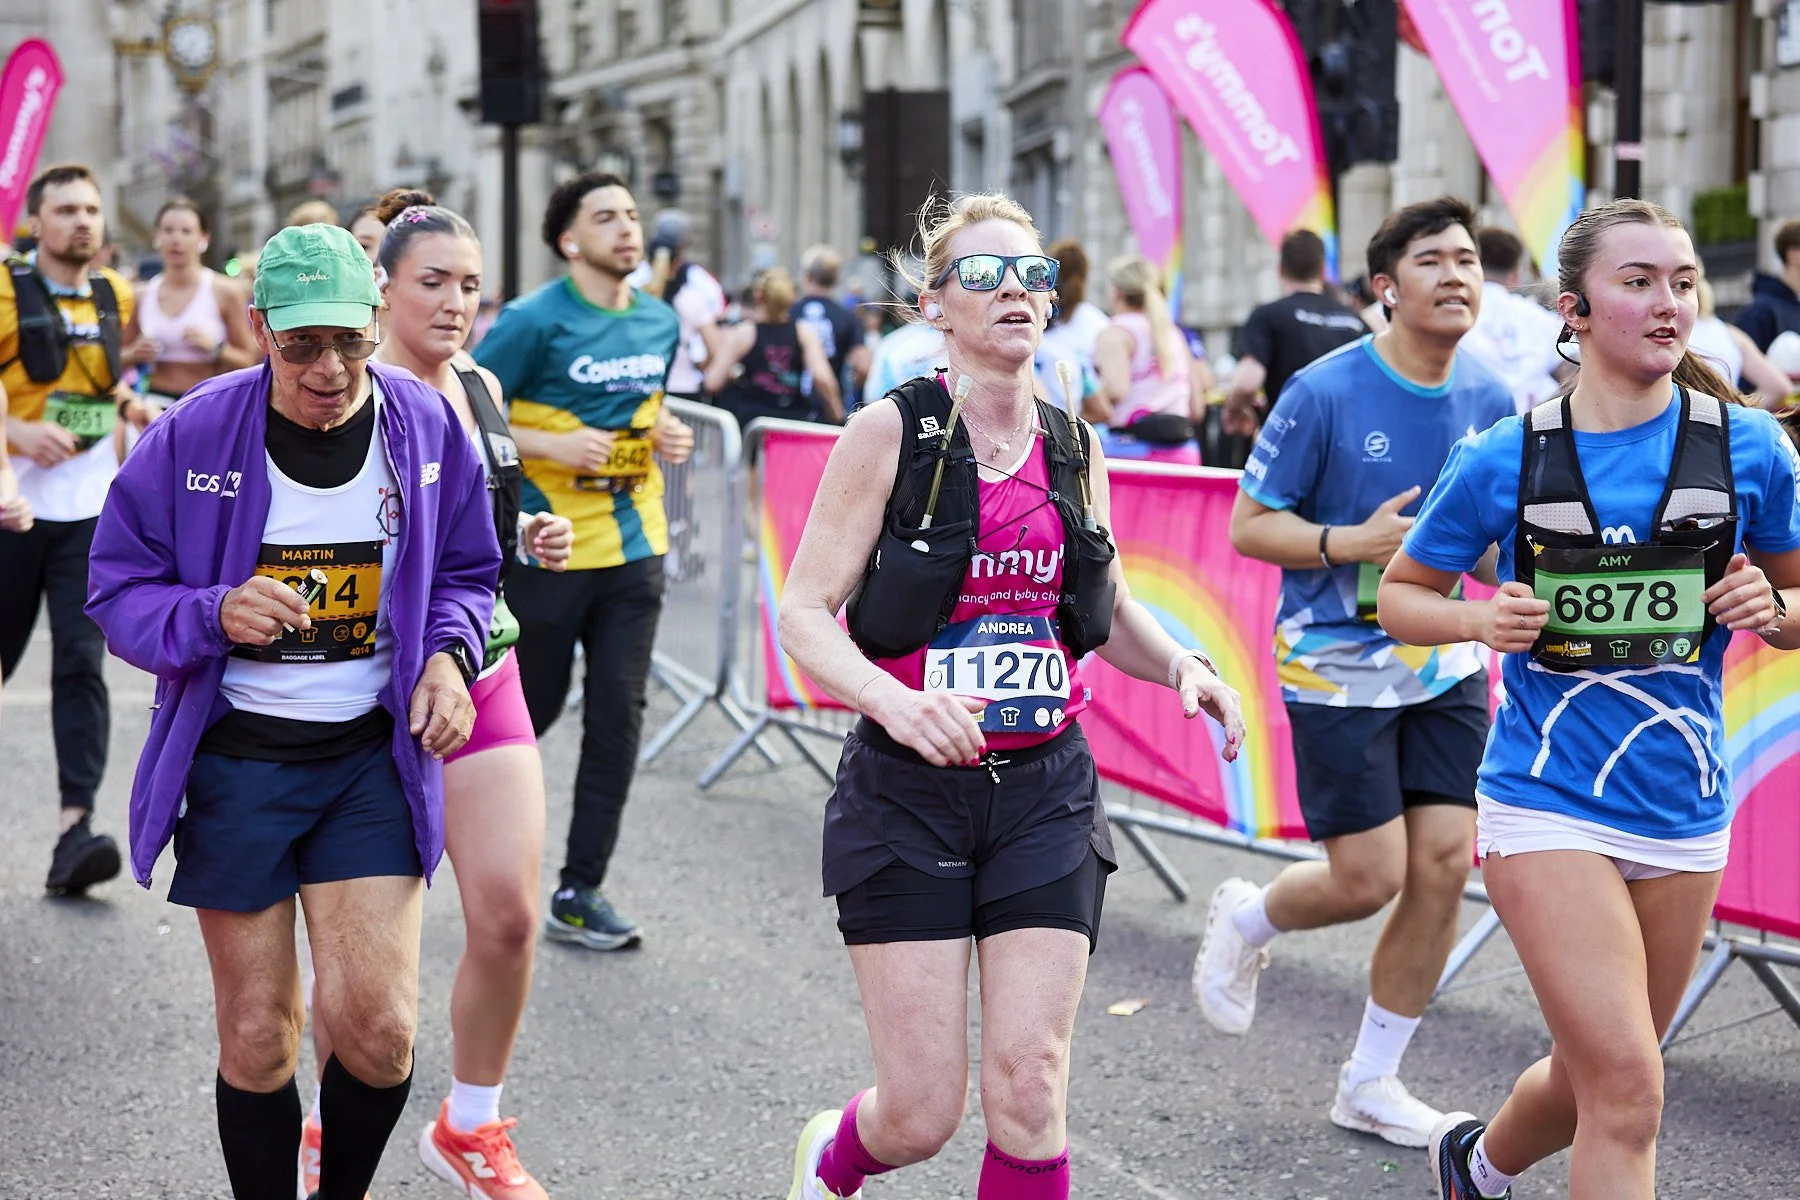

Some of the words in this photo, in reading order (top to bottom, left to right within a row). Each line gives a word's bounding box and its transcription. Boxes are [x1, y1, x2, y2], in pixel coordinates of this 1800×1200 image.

[607, 446, 648, 469] 642
[186, 469, 220, 493] tcs
[282, 549, 334, 560] MARTIN
[1598, 555, 1632, 567] AMY
[990, 590, 1011, 600] and
[1554, 581, 1679, 623] 6878
[977, 622, 1034, 635] ANDREA
[350, 646, 370, 656] 4014
[938, 651, 1063, 691] 11270
